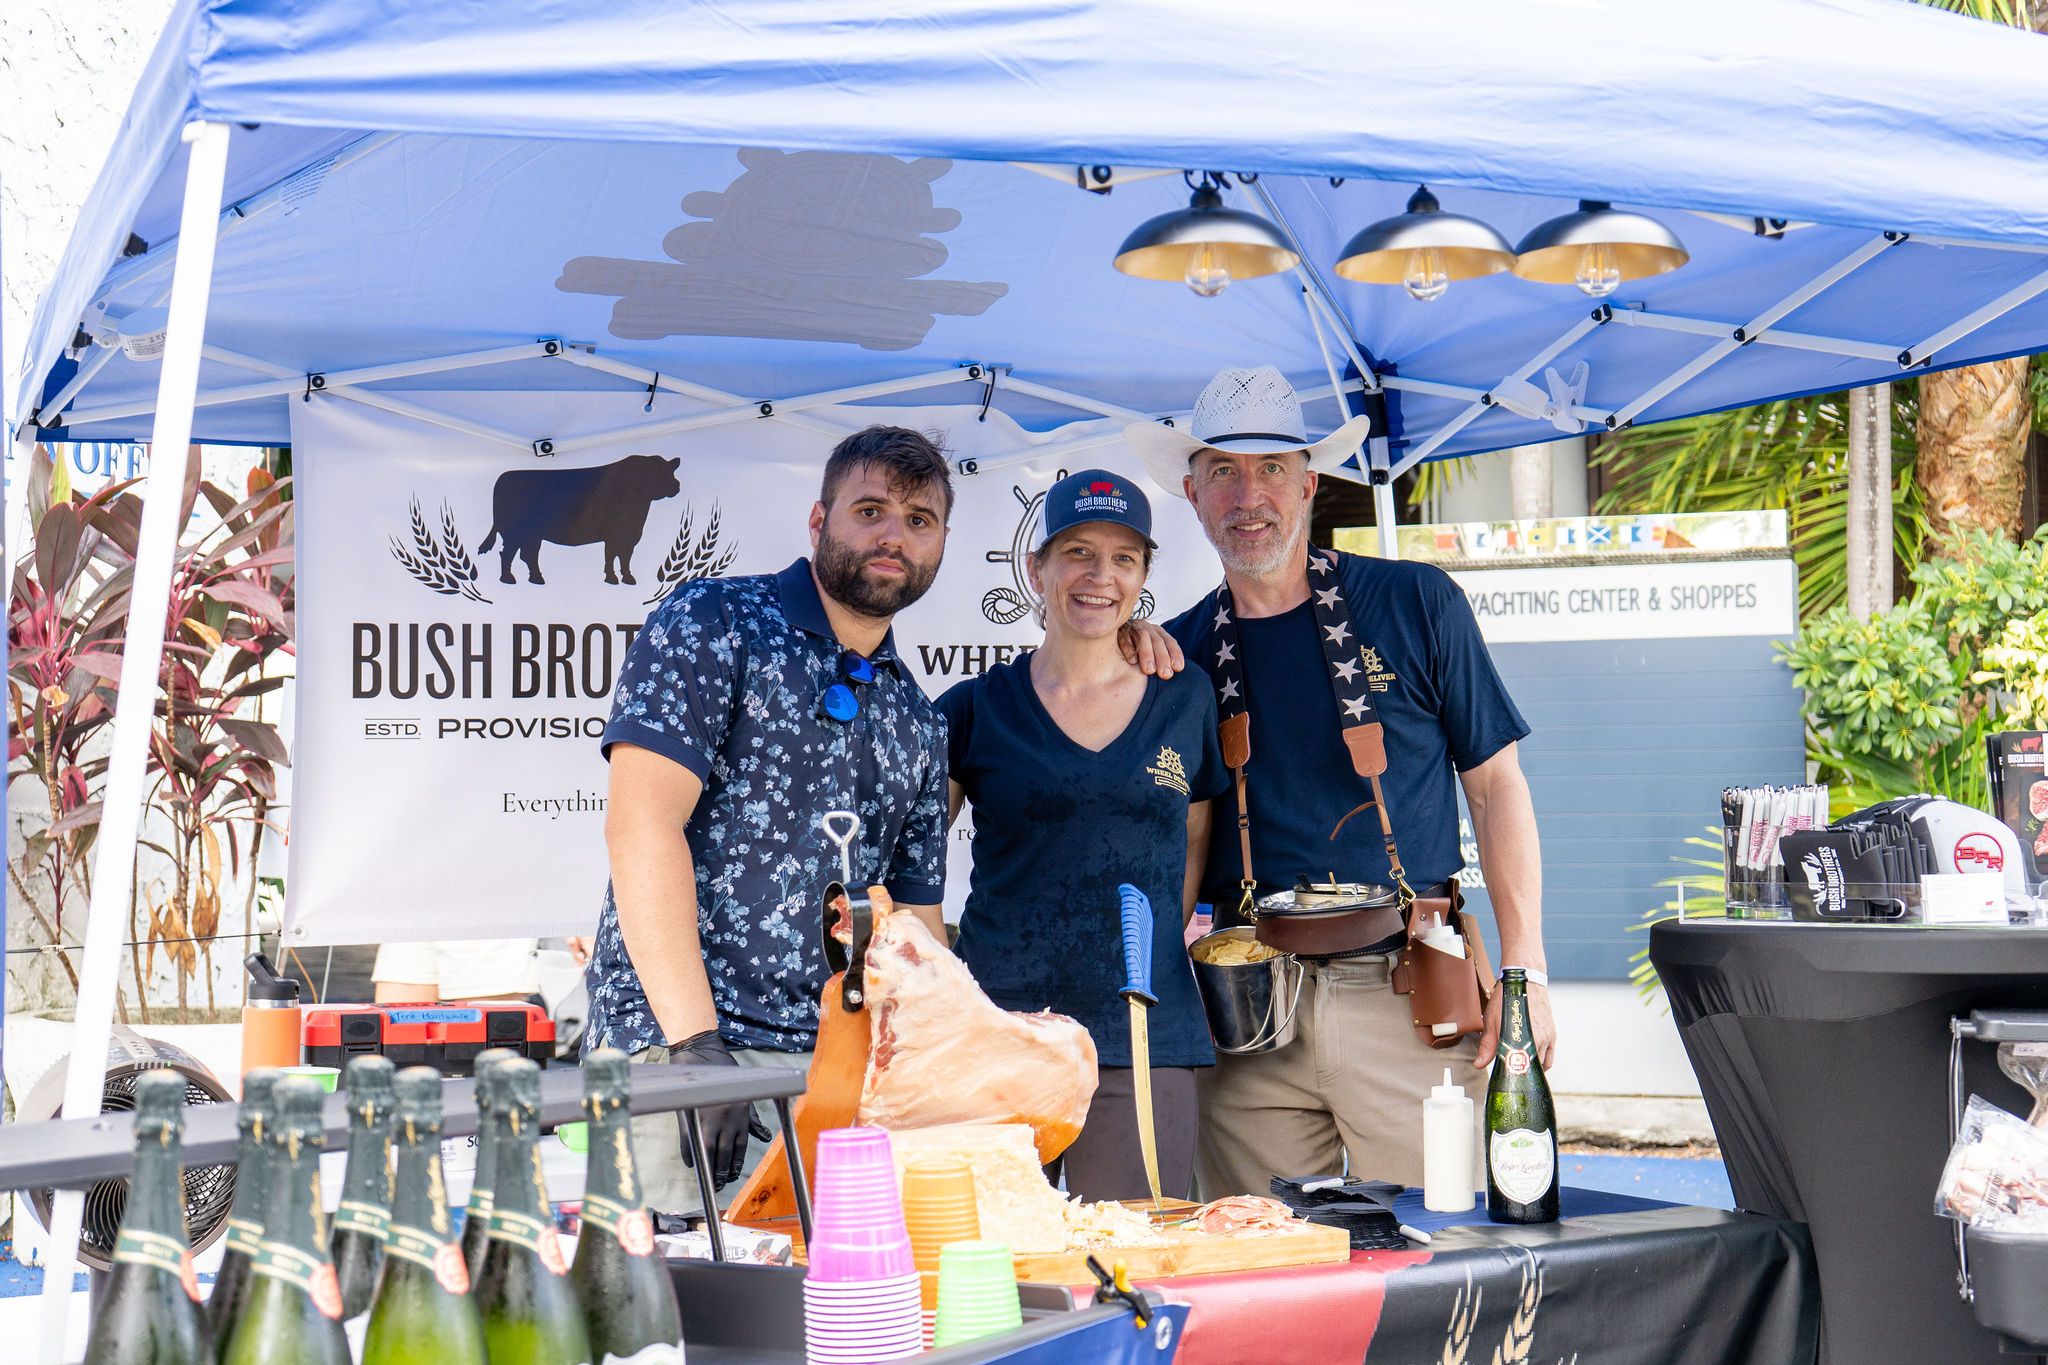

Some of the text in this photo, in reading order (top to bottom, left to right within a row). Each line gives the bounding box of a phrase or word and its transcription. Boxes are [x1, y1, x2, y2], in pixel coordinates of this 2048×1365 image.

[1075, 496, 1128, 510] BUSH BROTHERS
[1469, 583, 1758, 617] YACHTING CENTER & SHOPPES
[352, 622, 492, 699] BUSH
[917, 644, 1039, 676] WHE
[1368, 673, 1397, 682] ELIVER
[364, 717, 607, 739] ESTD. PROVISIO
[1818, 846, 1839, 887] BROTHERS
[1828, 887, 1841, 911] BUSH
